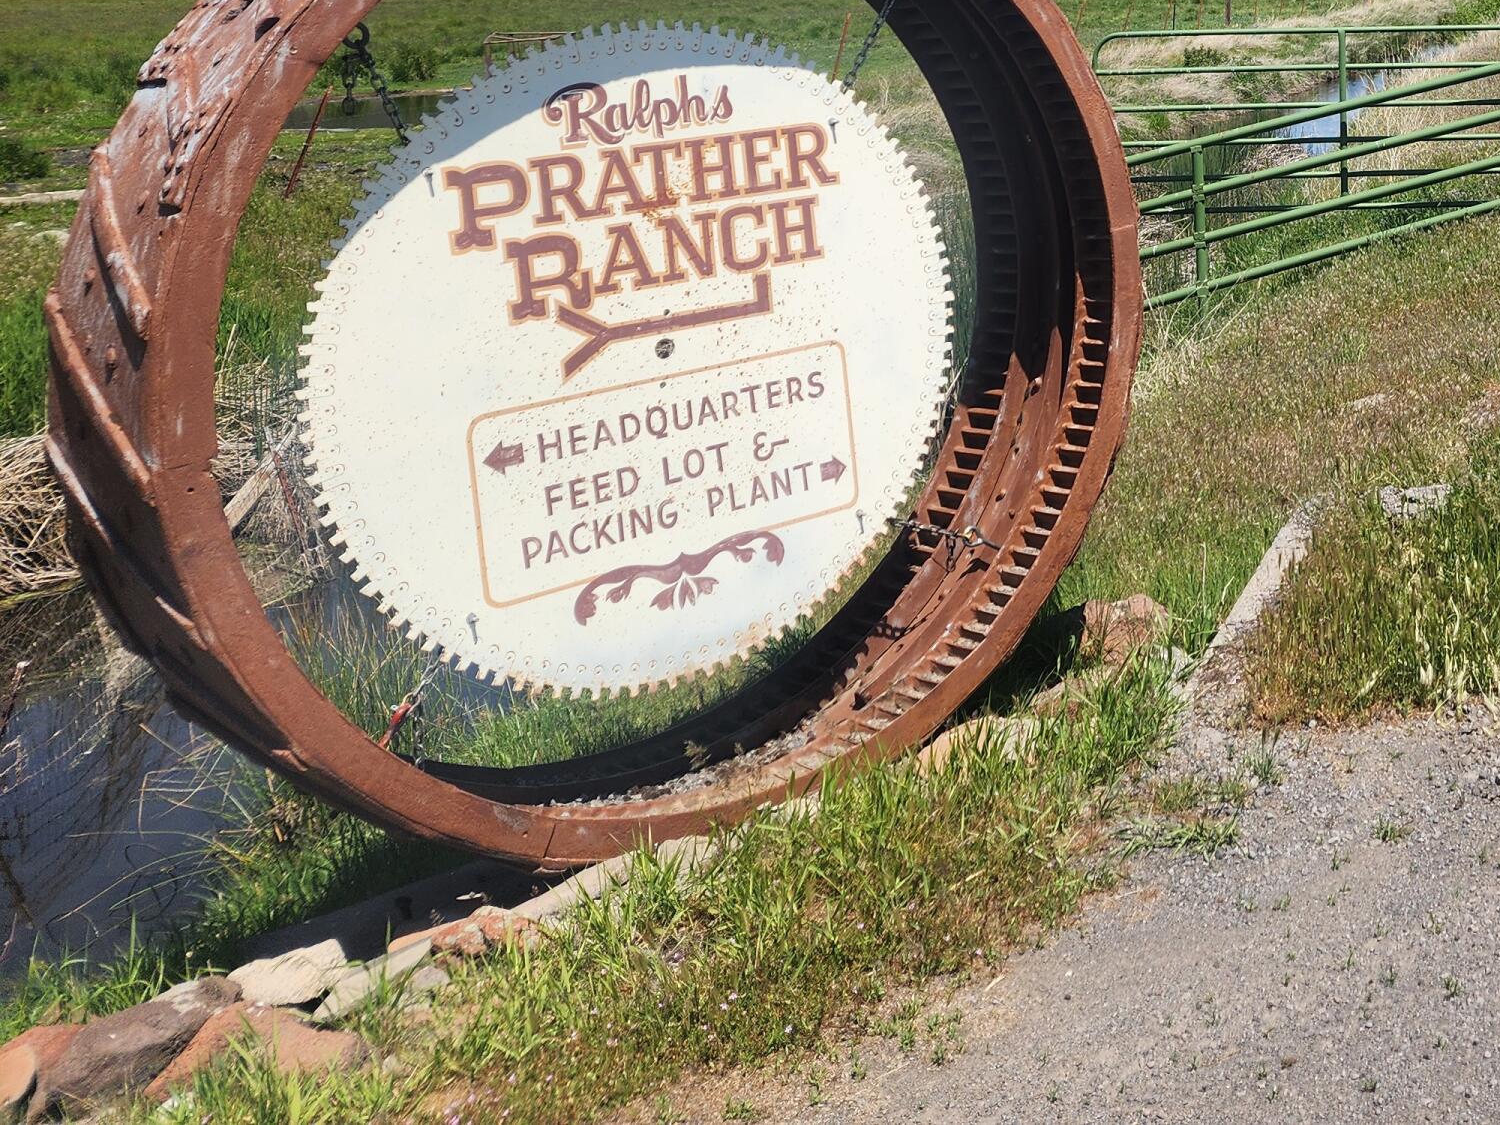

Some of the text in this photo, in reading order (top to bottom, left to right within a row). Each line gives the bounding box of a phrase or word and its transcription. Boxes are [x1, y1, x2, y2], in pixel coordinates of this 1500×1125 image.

[444, 123, 840, 255] PRATHER
[503, 195, 826, 326] RANCH
[536, 371, 826, 464] HEADQUARTERS
[520, 461, 815, 570] PACKING PLANT
[544, 431, 790, 516] FEED LOT &
